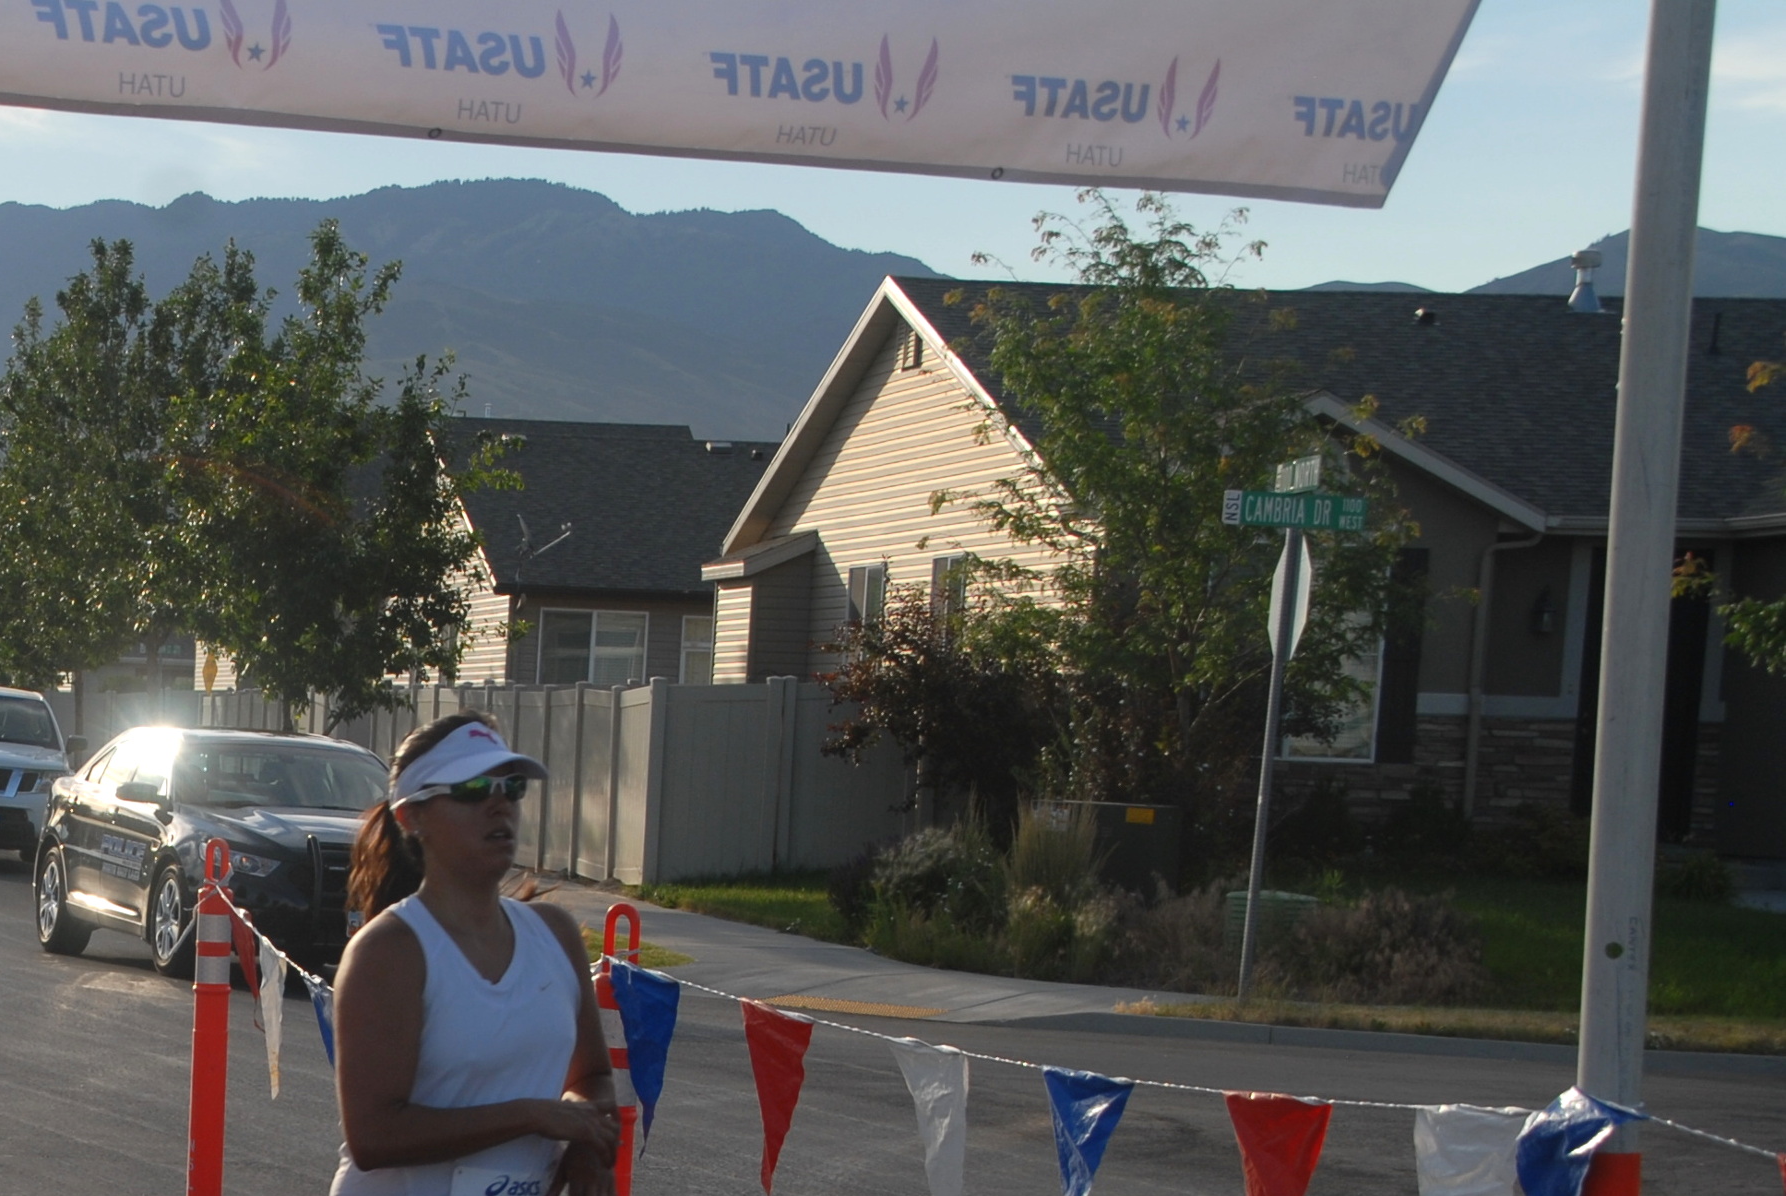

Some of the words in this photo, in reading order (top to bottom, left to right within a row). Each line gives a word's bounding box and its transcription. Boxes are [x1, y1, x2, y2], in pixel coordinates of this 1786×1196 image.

[1245, 495, 1305, 524] CAMBRIA
[1313, 499, 1332, 525] DR
[1338, 515, 1363, 530] WEST
[101, 833, 147, 862] POLICE
[507, 1180, 541, 1196] asics
